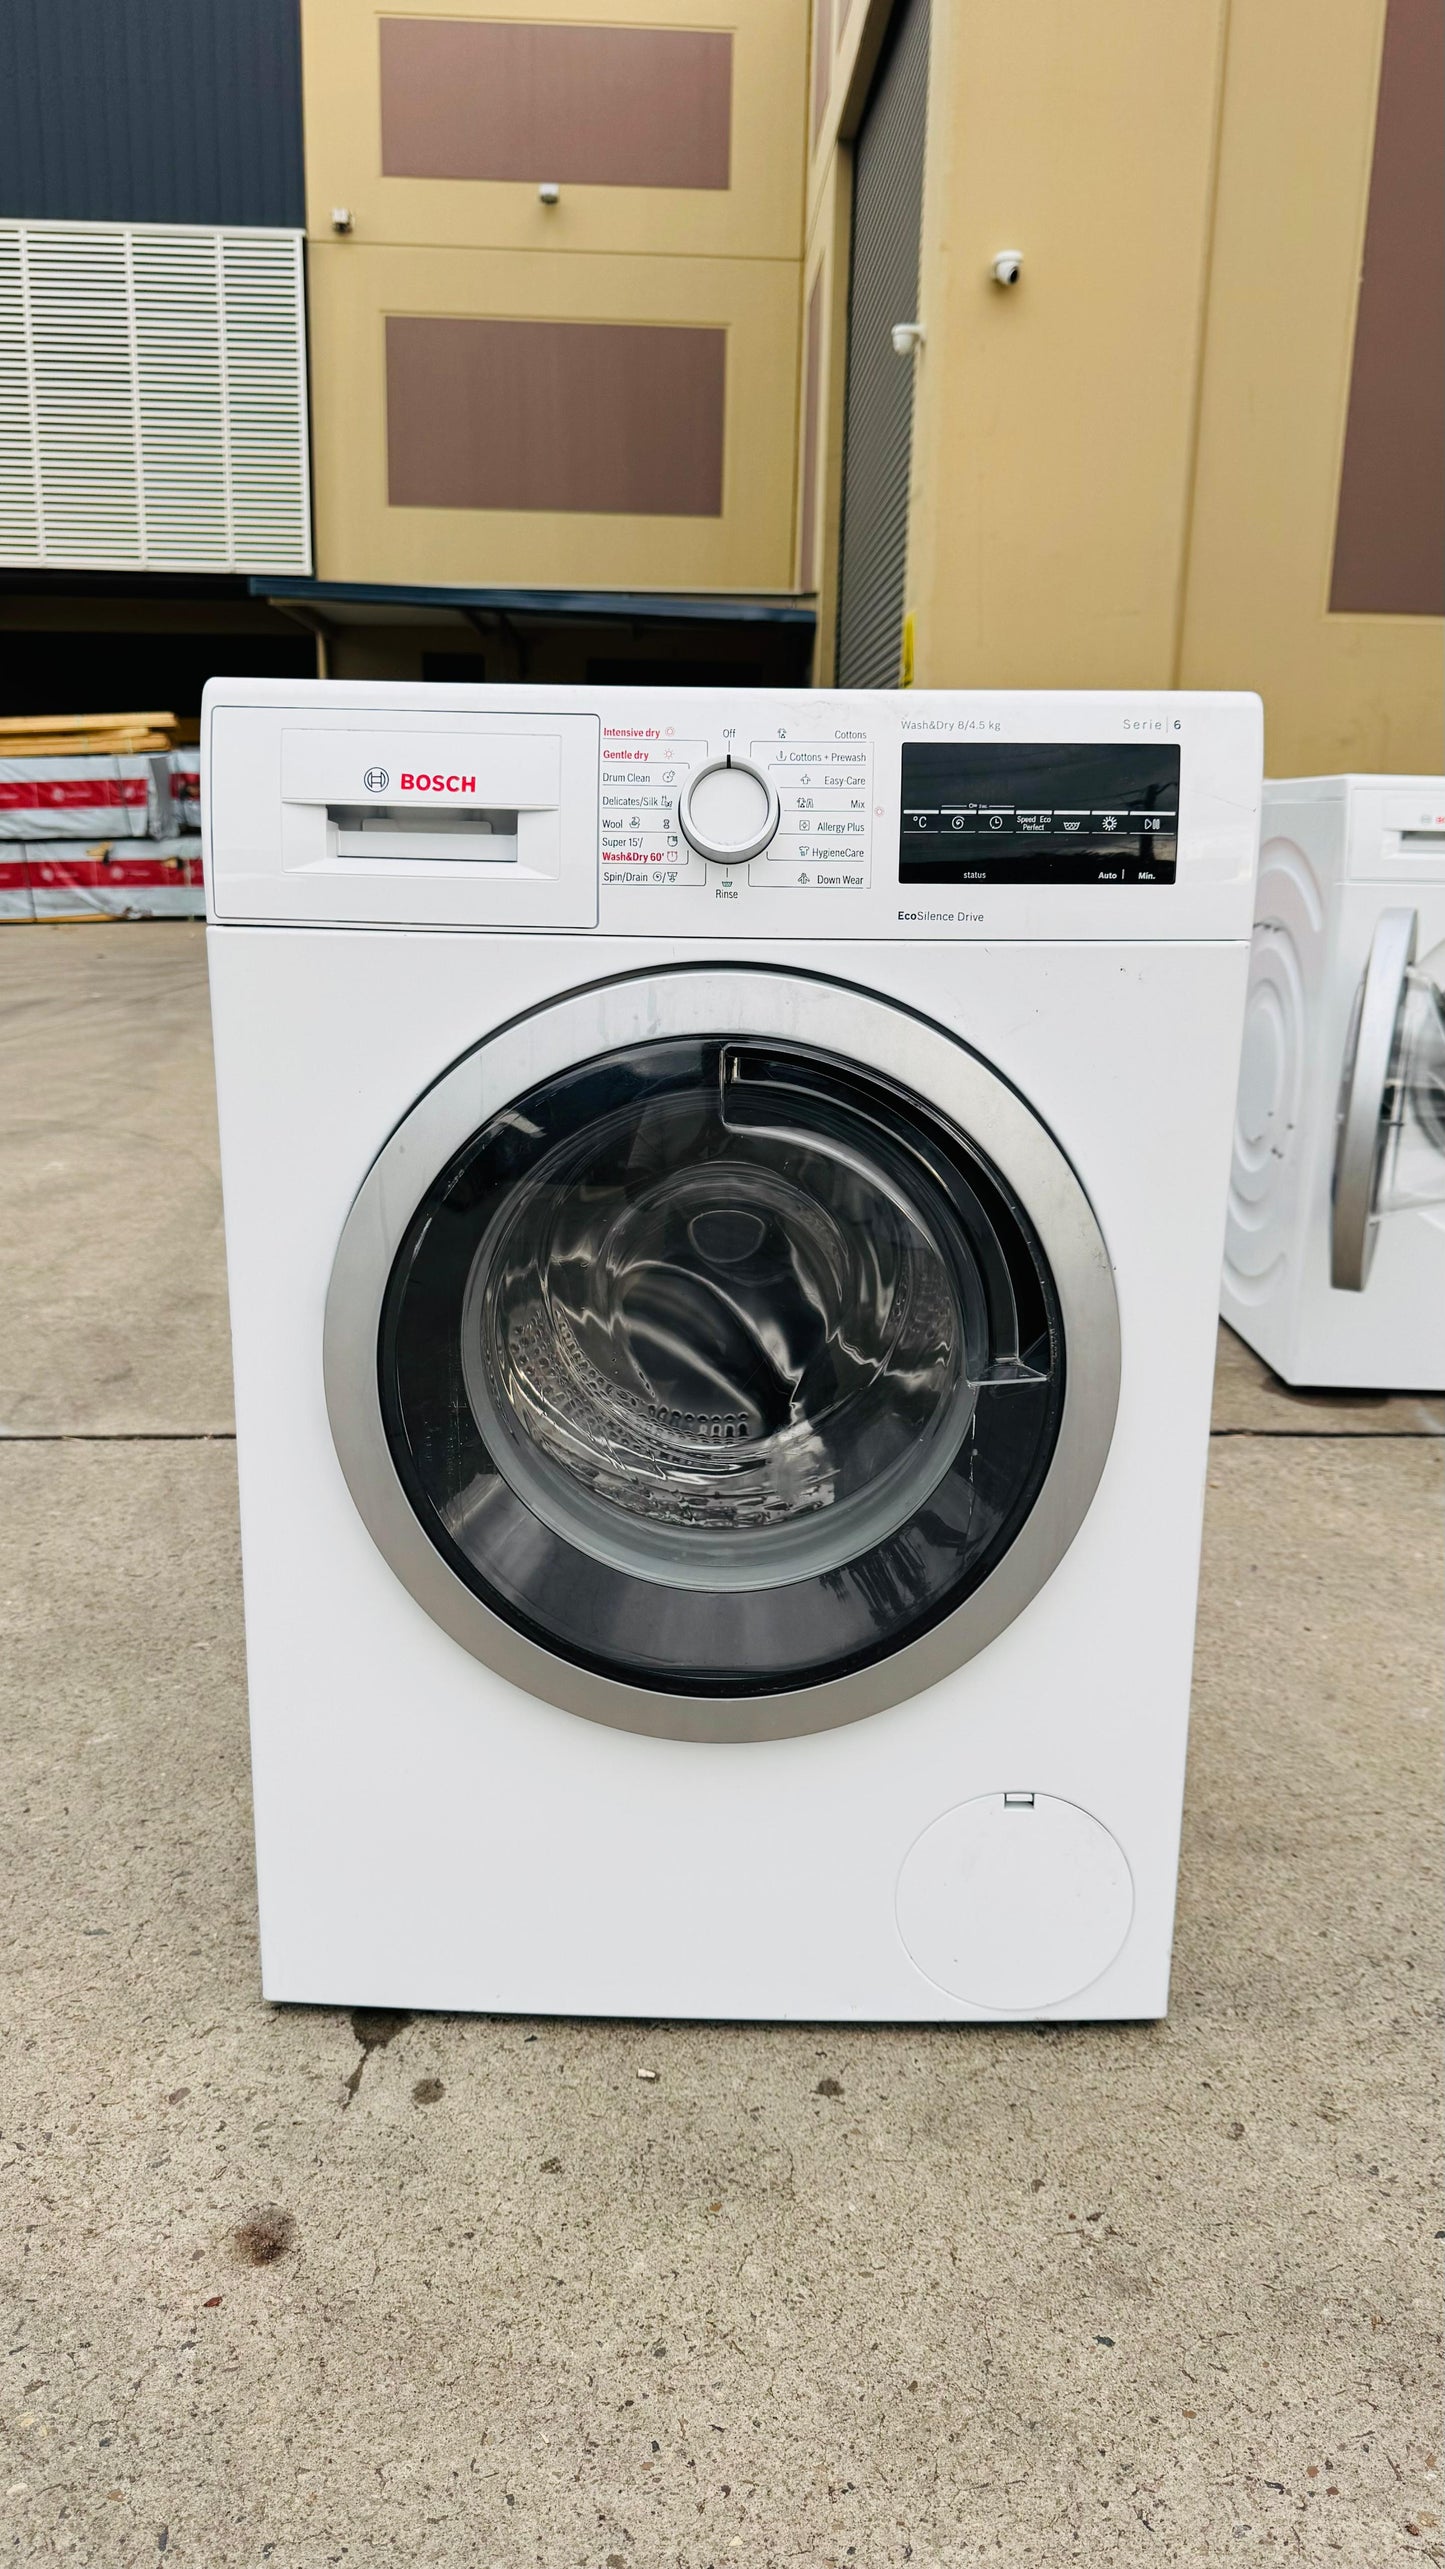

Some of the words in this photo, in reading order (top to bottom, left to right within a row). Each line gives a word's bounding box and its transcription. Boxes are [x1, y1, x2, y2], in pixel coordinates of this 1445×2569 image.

[901, 721, 954, 731] Wash&Dry
[958, 720, 985, 730] 8/4.5
[989, 721, 1000, 731] kg
[1124, 719, 1161, 730] Serie
[1174, 720, 1181, 730] 6
[603, 728, 643, 738] Intensive
[646, 728, 660, 738] dry
[723, 729, 735, 739] Off
[835, 730, 866, 740] Cottons
[603, 750, 632, 760] Gentle
[634, 751, 648, 761] dry
[790, 753, 821, 761] Cottons
[832, 753, 866, 761] Prewash
[603, 773, 625, 781] Drum
[627, 773, 650, 782] Clean
[400, 773, 476, 793] BOSCH
[603, 797, 658, 807] Delicates/Silk
[851, 800, 864, 809] Mix
[602, 820, 622, 828] Wool
[1016, 815, 1037, 824] Speed
[1040, 816, 1051, 824] Eco
[818, 822, 845, 833] Allergy
[848, 823, 864, 831] Plus
[603, 838, 626, 848] Super
[602, 852, 649, 862] Wash&Dry
[813, 848, 864, 858] HygieneCare
[604, 872, 647, 883] Spin/Drain
[818, 875, 840, 884] Down
[843, 876, 863, 884] Wear
[716, 889, 738, 898] Rinse
[898, 911, 954, 921] EcoSilence
[958, 912, 984, 921] Drive
